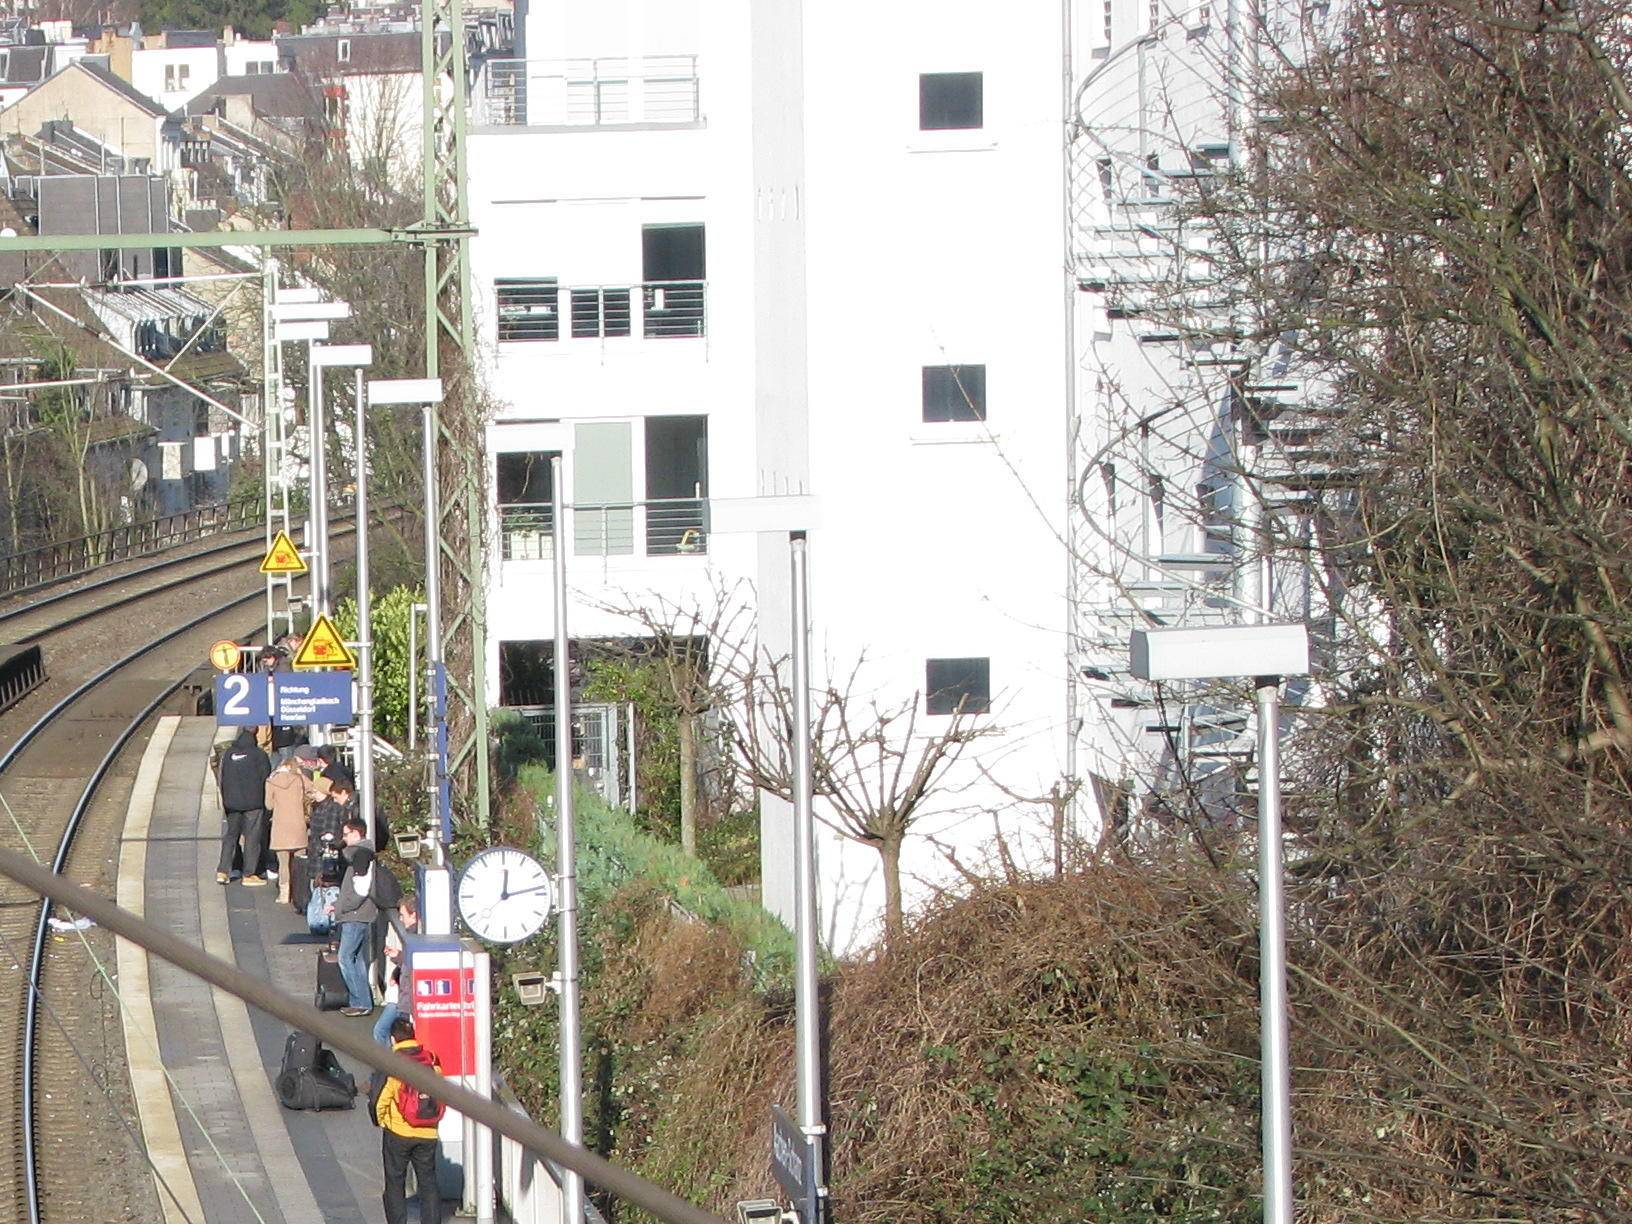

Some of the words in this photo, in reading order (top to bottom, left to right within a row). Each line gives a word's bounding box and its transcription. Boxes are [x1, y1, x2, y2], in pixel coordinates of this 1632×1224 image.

[224, 675, 250, 715] 2
[280, 686, 310, 695] Richtung
[280, 705, 316, 713] Düsseldorf
